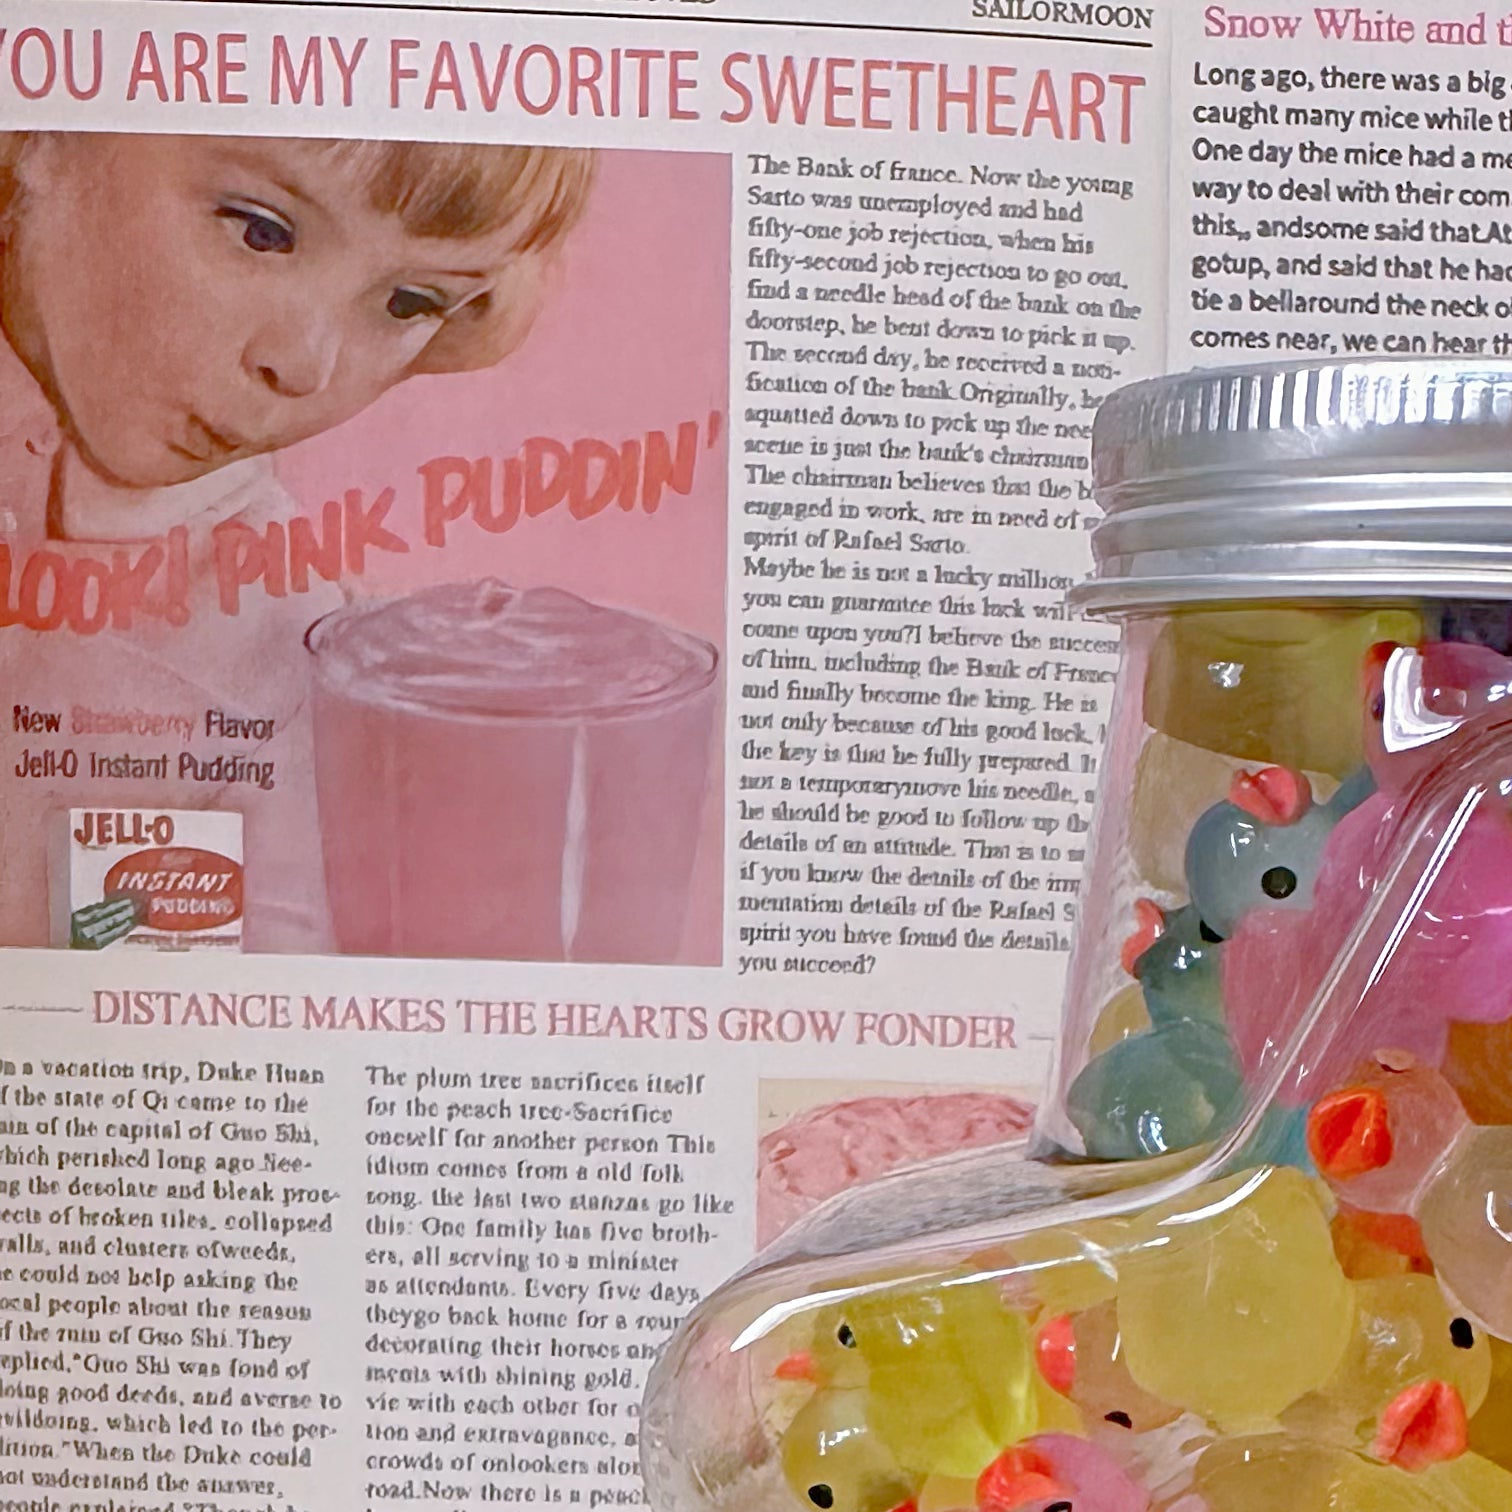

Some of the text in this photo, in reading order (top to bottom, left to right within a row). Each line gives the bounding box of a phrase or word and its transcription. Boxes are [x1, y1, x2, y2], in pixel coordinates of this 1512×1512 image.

[972, 0, 1154, 29] SAILORMOON
[1204, 5, 1302, 38] Snow
[1313, 7, 1415, 43] White
[1425, 11, 1487, 45] and
[0, 27, 1146, 144] OU ARE MY FAVORITE SWEETHEART
[1193, 61, 1256, 91] Long
[1260, 69, 1315, 92] ago,
[1319, 65, 1386, 89] there
[1390, 73, 1440, 91] was
[1446, 75, 1460, 92] a
[1467, 69, 1506, 99] big
[1192, 100, 1279, 129] caught
[1284, 107, 1355, 132] many
[1359, 105, 1419, 129] mice
[1423, 106, 1493, 131] while
[1191, 137, 1243, 161] One
[1247, 139, 1293, 168] day
[1298, 140, 1338, 163] the
[1343, 141, 1403, 166] mice
[1408, 143, 1455, 167] had
[1460, 151, 1475, 168] a
[747, 154, 790, 174] The
[796, 156, 854, 177] Bank
[859, 160, 885, 179] of
[969, 164, 1021, 185] Now
[1026, 168, 1060, 189] the
[212, 487, 410, 616] PINK
[417, 410, 721, 547] PUDDIN'
[13, 704, 62, 733] New
[205, 709, 275, 739] Flavor
[15, 749, 275, 790] Jell-O Instant Pudding
[74, 812, 175, 846] JELL-O
[117, 871, 234, 892] INSTANT
[92, 991, 1017, 1048] DISTANCE MAKES THE HEARTS GROW FONDER
